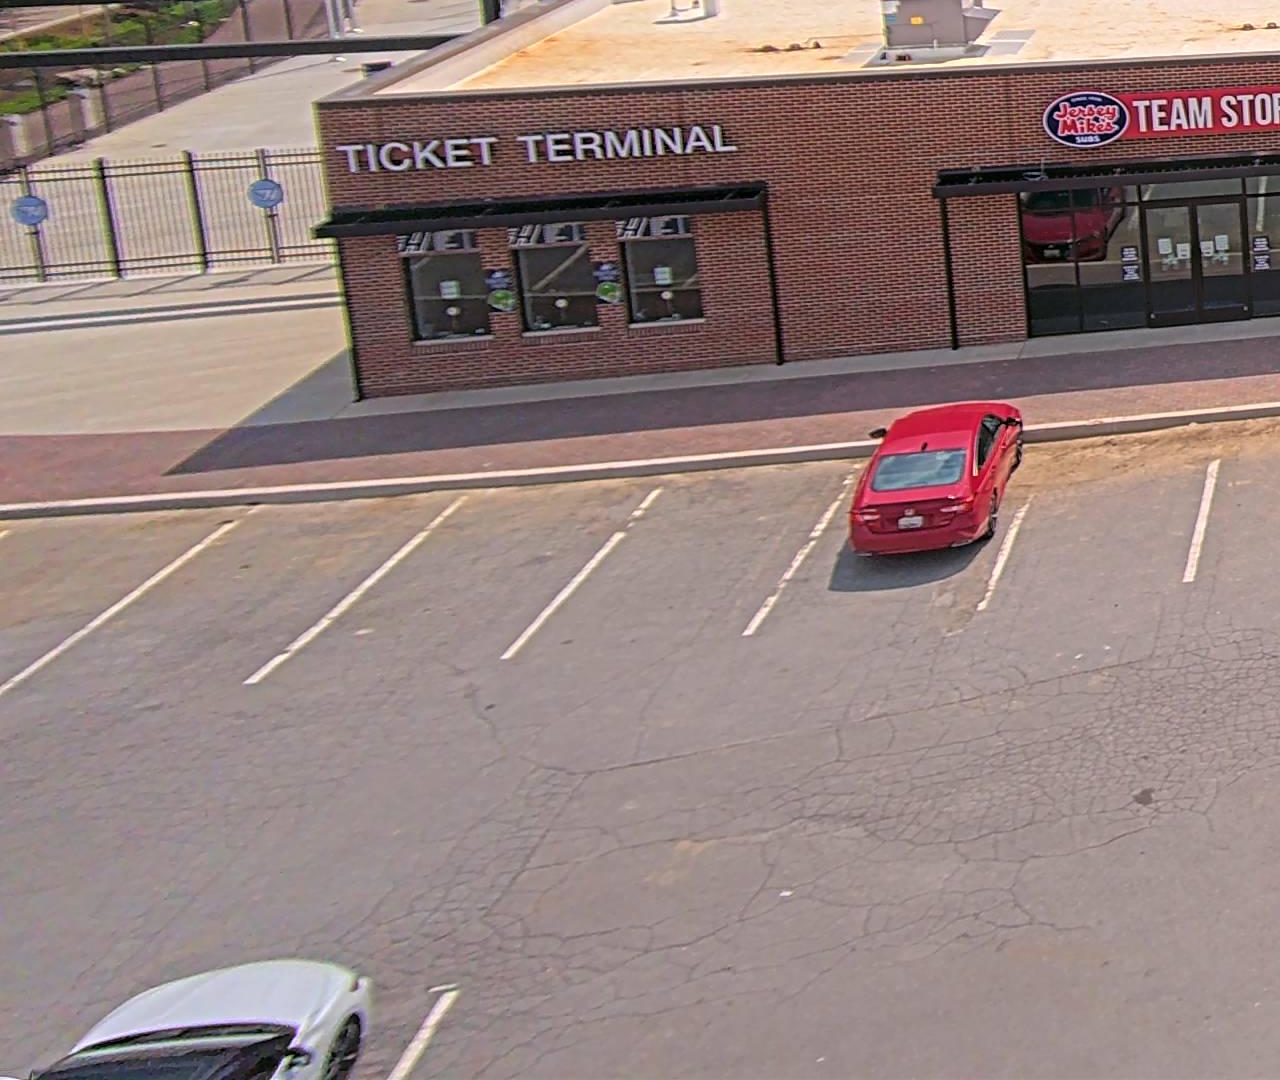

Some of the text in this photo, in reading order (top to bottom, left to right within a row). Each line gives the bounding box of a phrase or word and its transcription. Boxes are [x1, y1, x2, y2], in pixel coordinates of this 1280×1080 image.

[1053, 102, 1119, 122] Jersey
[1132, 97, 1214, 133] TEAM
[336, 125, 738, 173] TICKET TERMINAL
